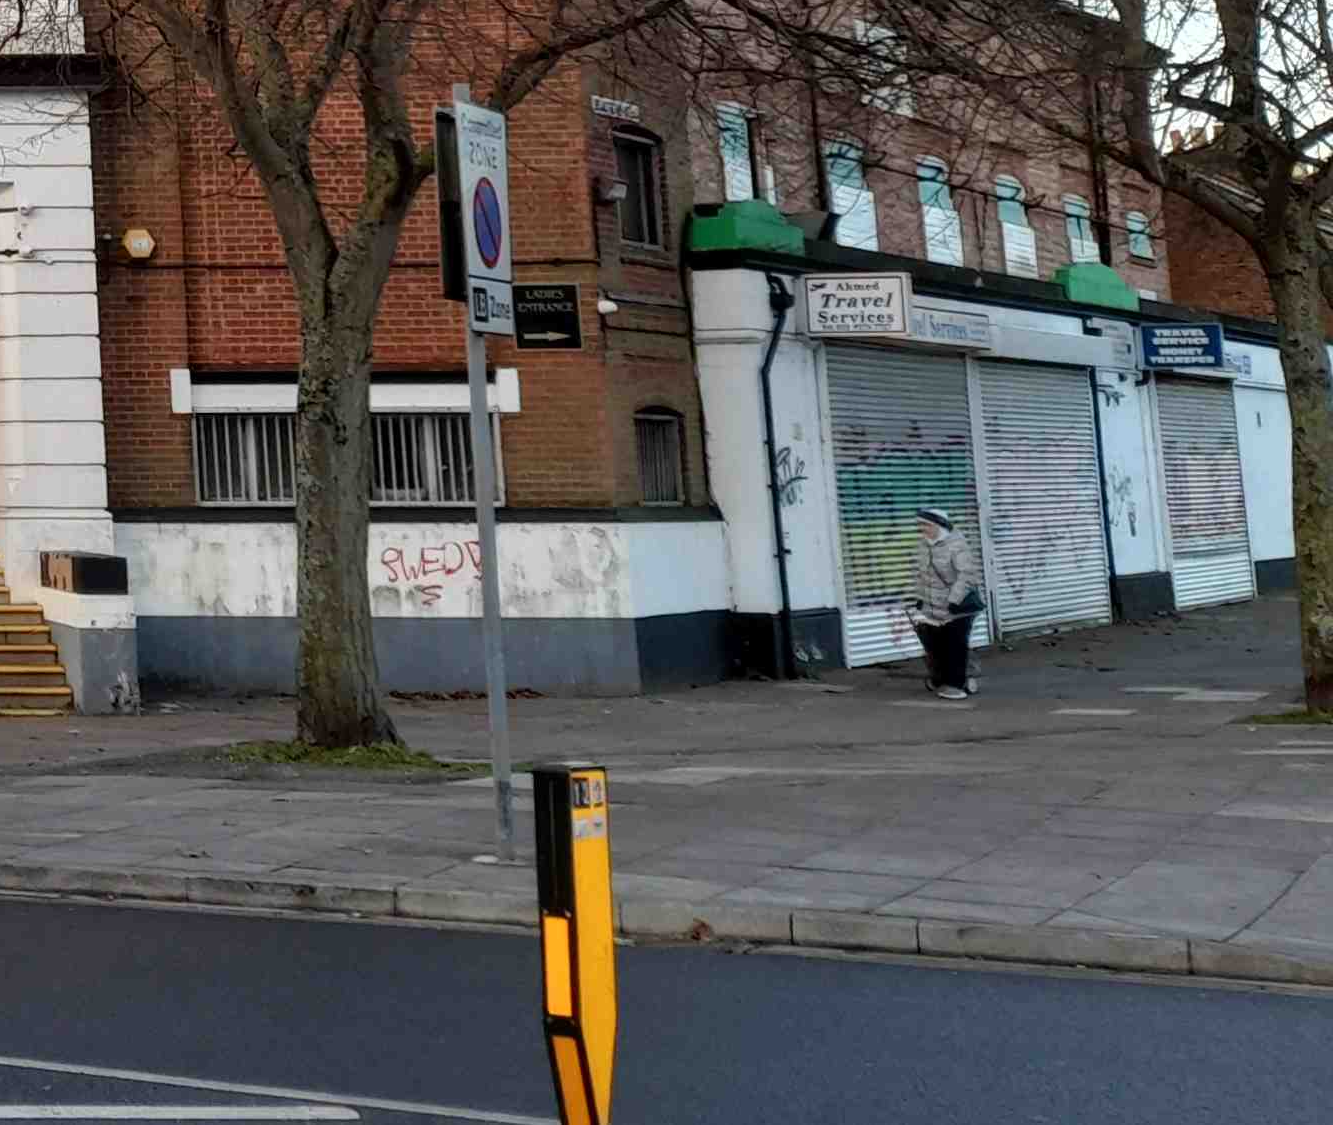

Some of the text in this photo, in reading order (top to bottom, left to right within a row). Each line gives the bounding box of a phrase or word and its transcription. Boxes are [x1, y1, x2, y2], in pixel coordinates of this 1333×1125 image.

[469, 141, 498, 170] ZONE
[525, 289, 565, 300] LADIES
[821, 292, 894, 309] Travel
[516, 302, 574, 313] ENTRANCE
[817, 310, 895, 325] Services
[1153, 328, 1207, 337] TRAVEL
[1158, 347, 1204, 356] MONEY
